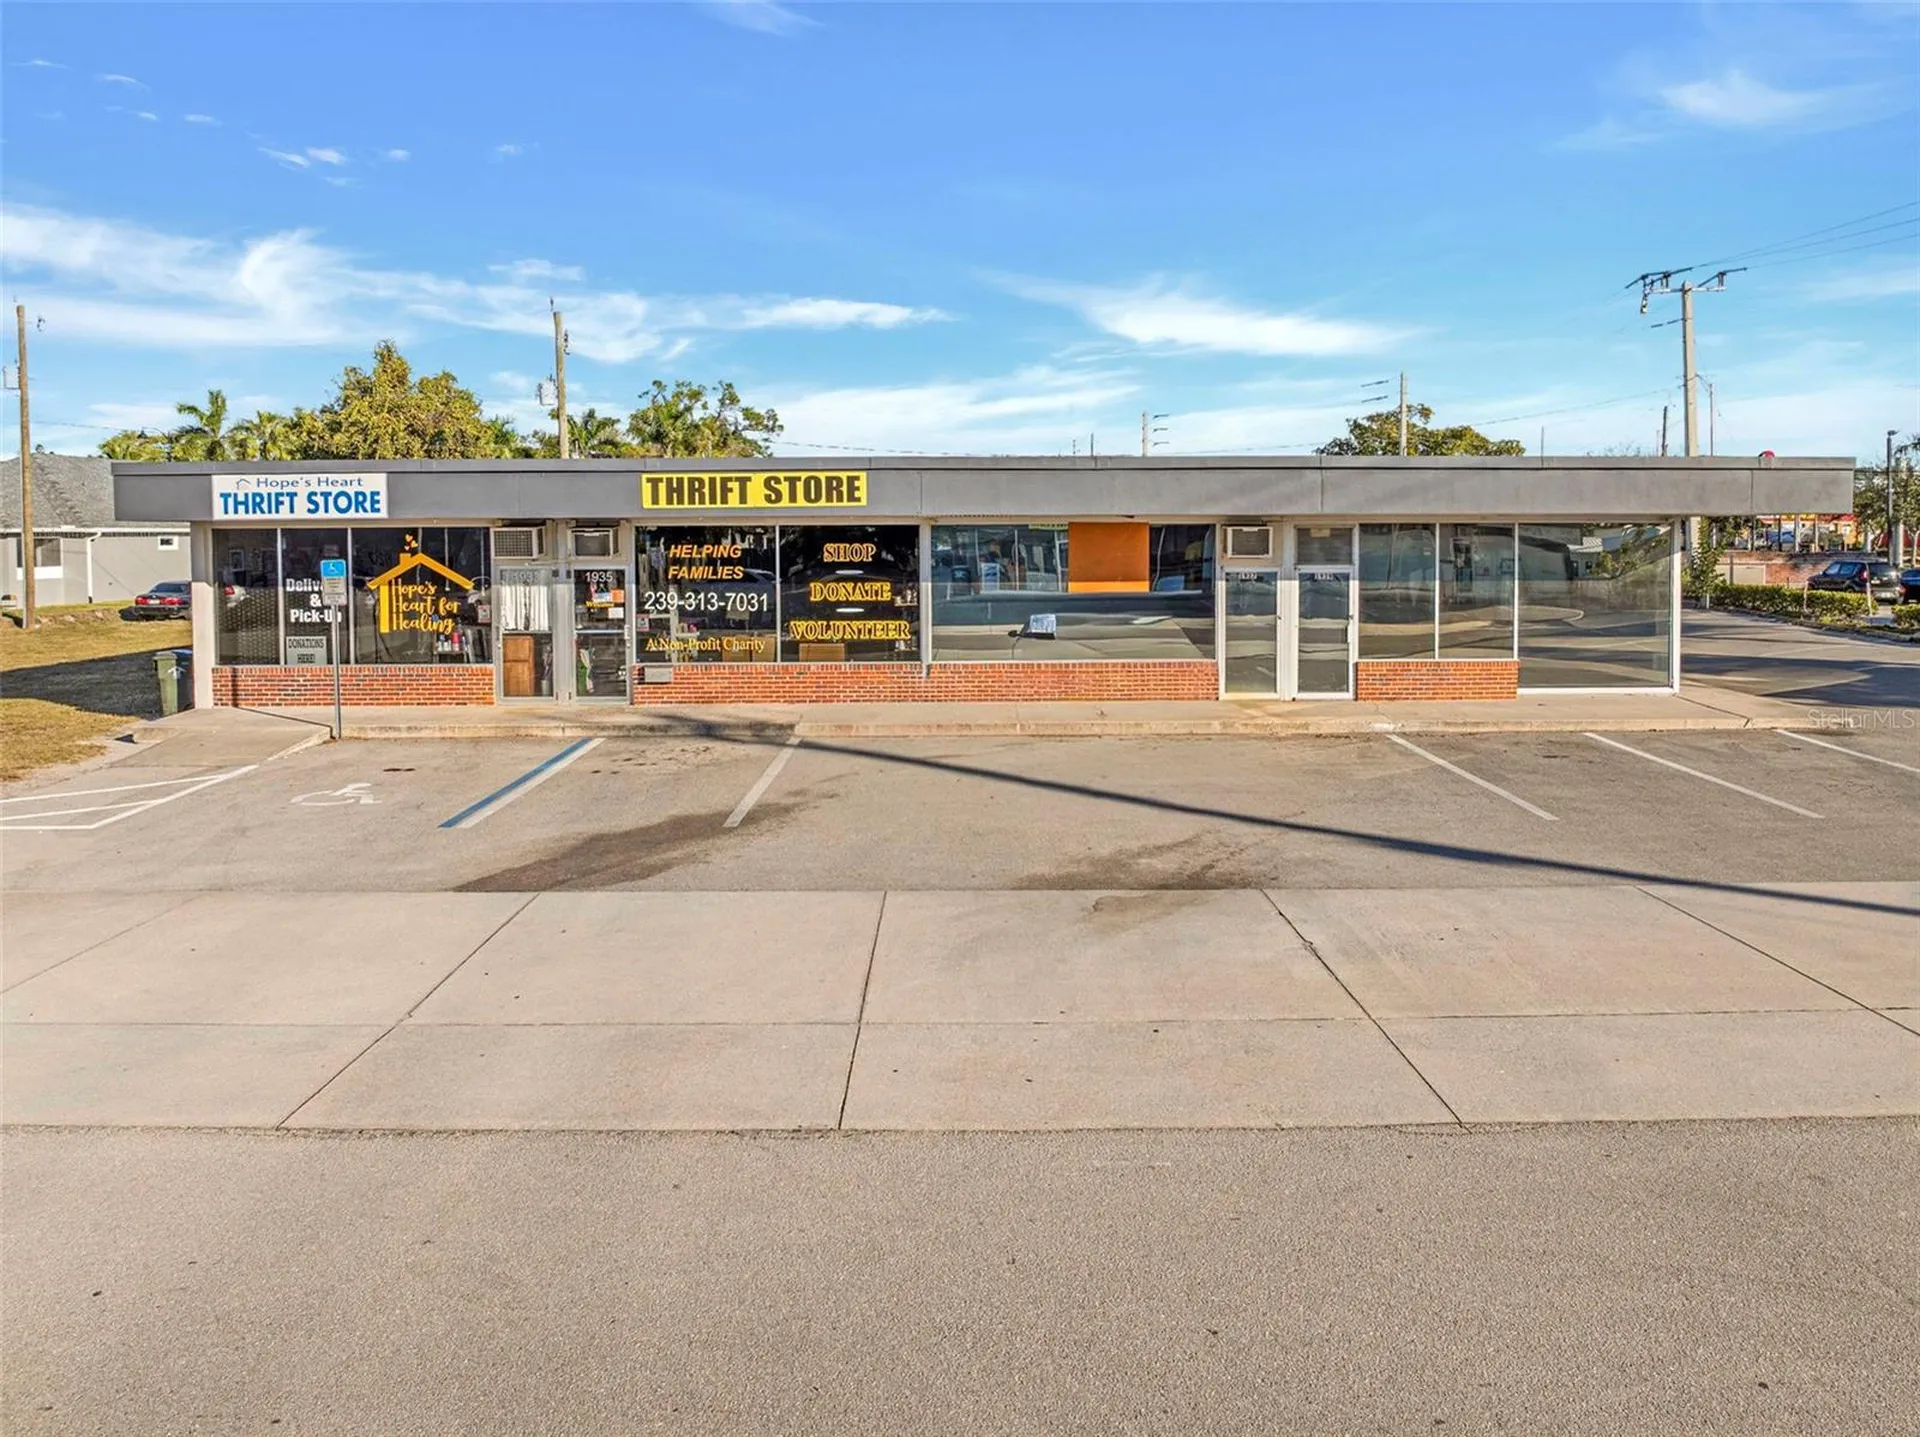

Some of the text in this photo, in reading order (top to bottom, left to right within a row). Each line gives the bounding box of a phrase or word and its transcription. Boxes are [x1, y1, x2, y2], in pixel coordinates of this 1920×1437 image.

[256, 476, 364, 489] Hope's Heart
[646, 475, 861, 506] THRIFT STORE
[219, 490, 381, 515] THRIFT STORE
[669, 544, 743, 559] HELPING
[823, 543, 877, 562] SHOP
[585, 571, 614, 583] 1935
[667, 566, 745, 579] FAMILIES
[286, 578, 324, 592] Deliv
[391, 578, 437, 599] Hope's
[809, 582, 892, 601] DONATE
[309, 593, 322, 608] &
[392, 595, 462, 616] Heart for
[644, 591, 768, 612] 239-313-7031
[392, 613, 455, 635] Healing
[790, 620, 912, 640] VOLUNTEER
[288, 638, 325, 649] DONATIONS
[645, 636, 766, 654] A Non-Profit Charity
